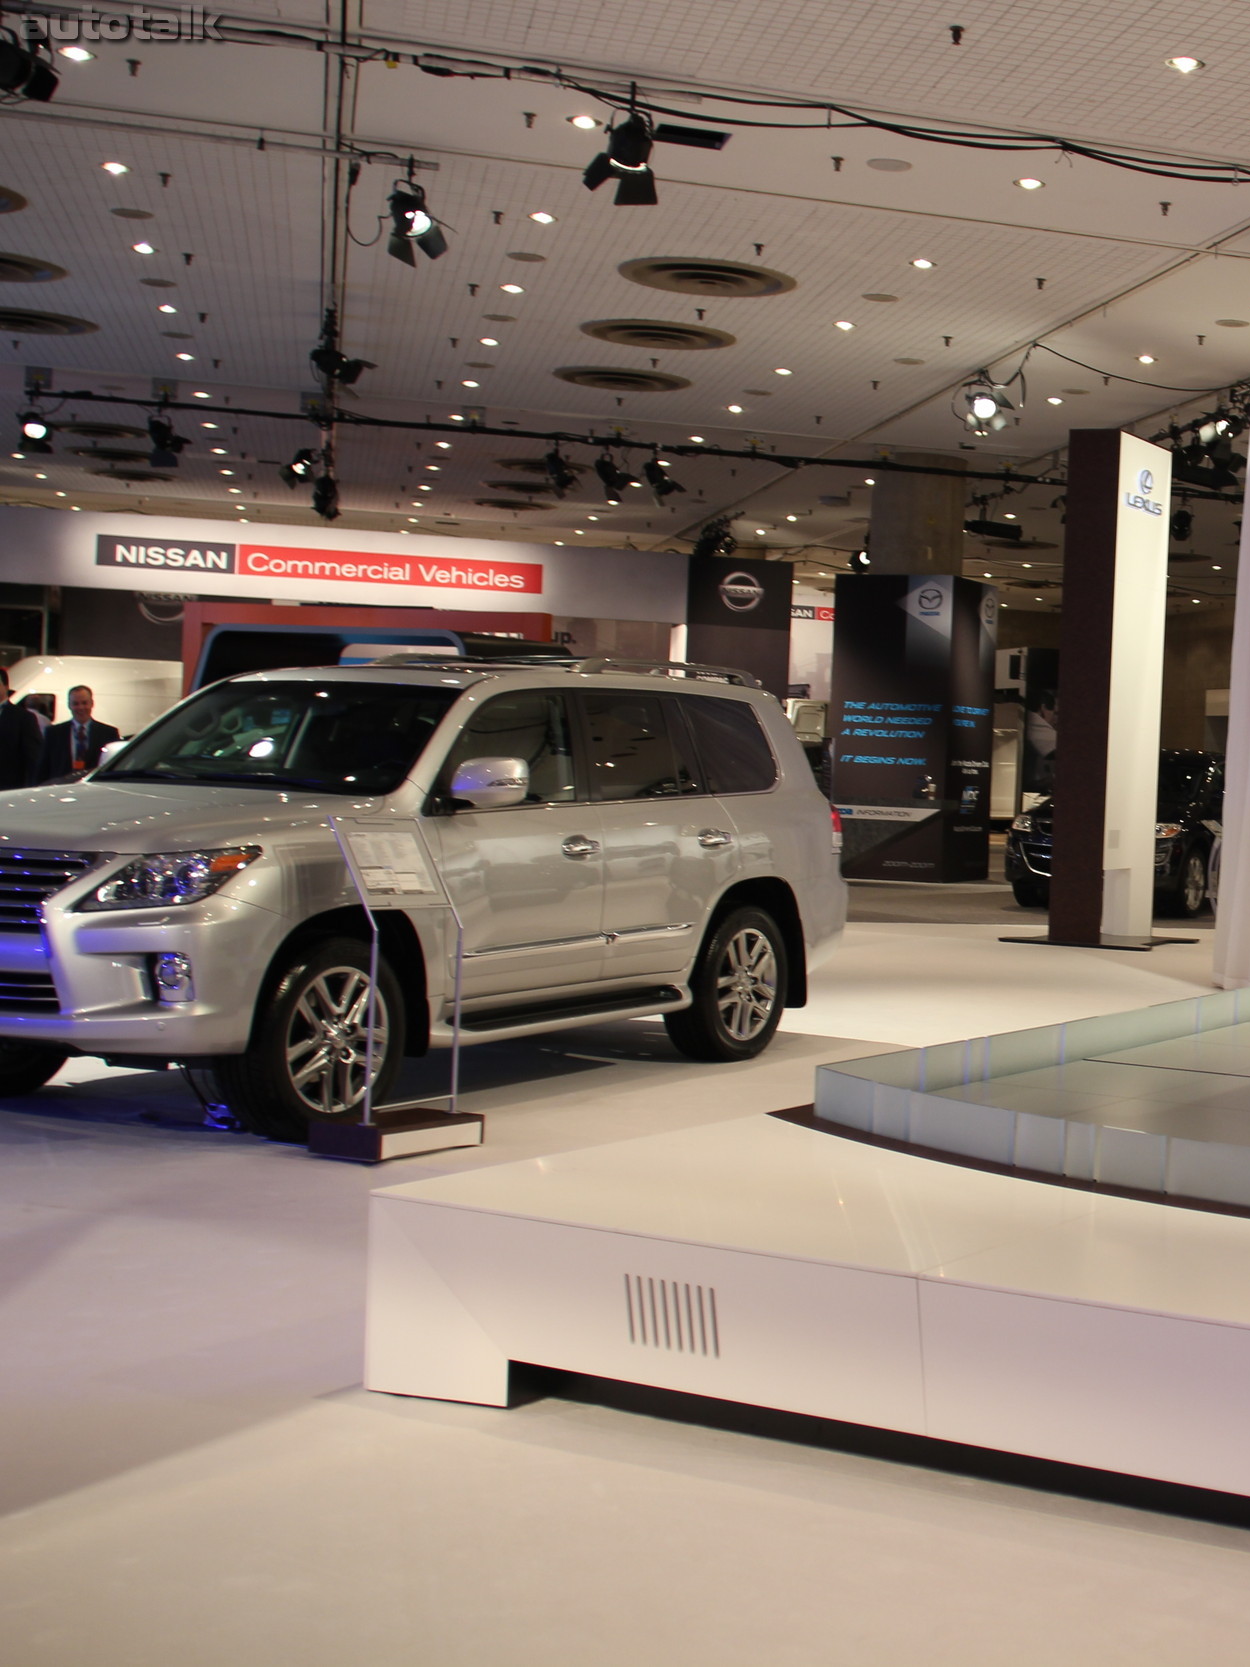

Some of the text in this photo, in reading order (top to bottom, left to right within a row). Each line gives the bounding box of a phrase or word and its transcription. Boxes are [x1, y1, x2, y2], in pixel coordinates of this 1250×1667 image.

[1125, 492, 1163, 516] LEXUS
[115, 544, 525, 589] NISSAN Commercial Vehicles
[844, 701, 867, 710] THE
[868, 702, 943, 712] AUTOMOTIVE
[843, 715, 934, 725] WORLD NEEDED
[841, 728, 926, 738] A REVOLUTION
[840, 755, 853, 763] IT
[854, 755, 896, 765] BEGINS
[856, 809, 912, 817] INFORMATION
